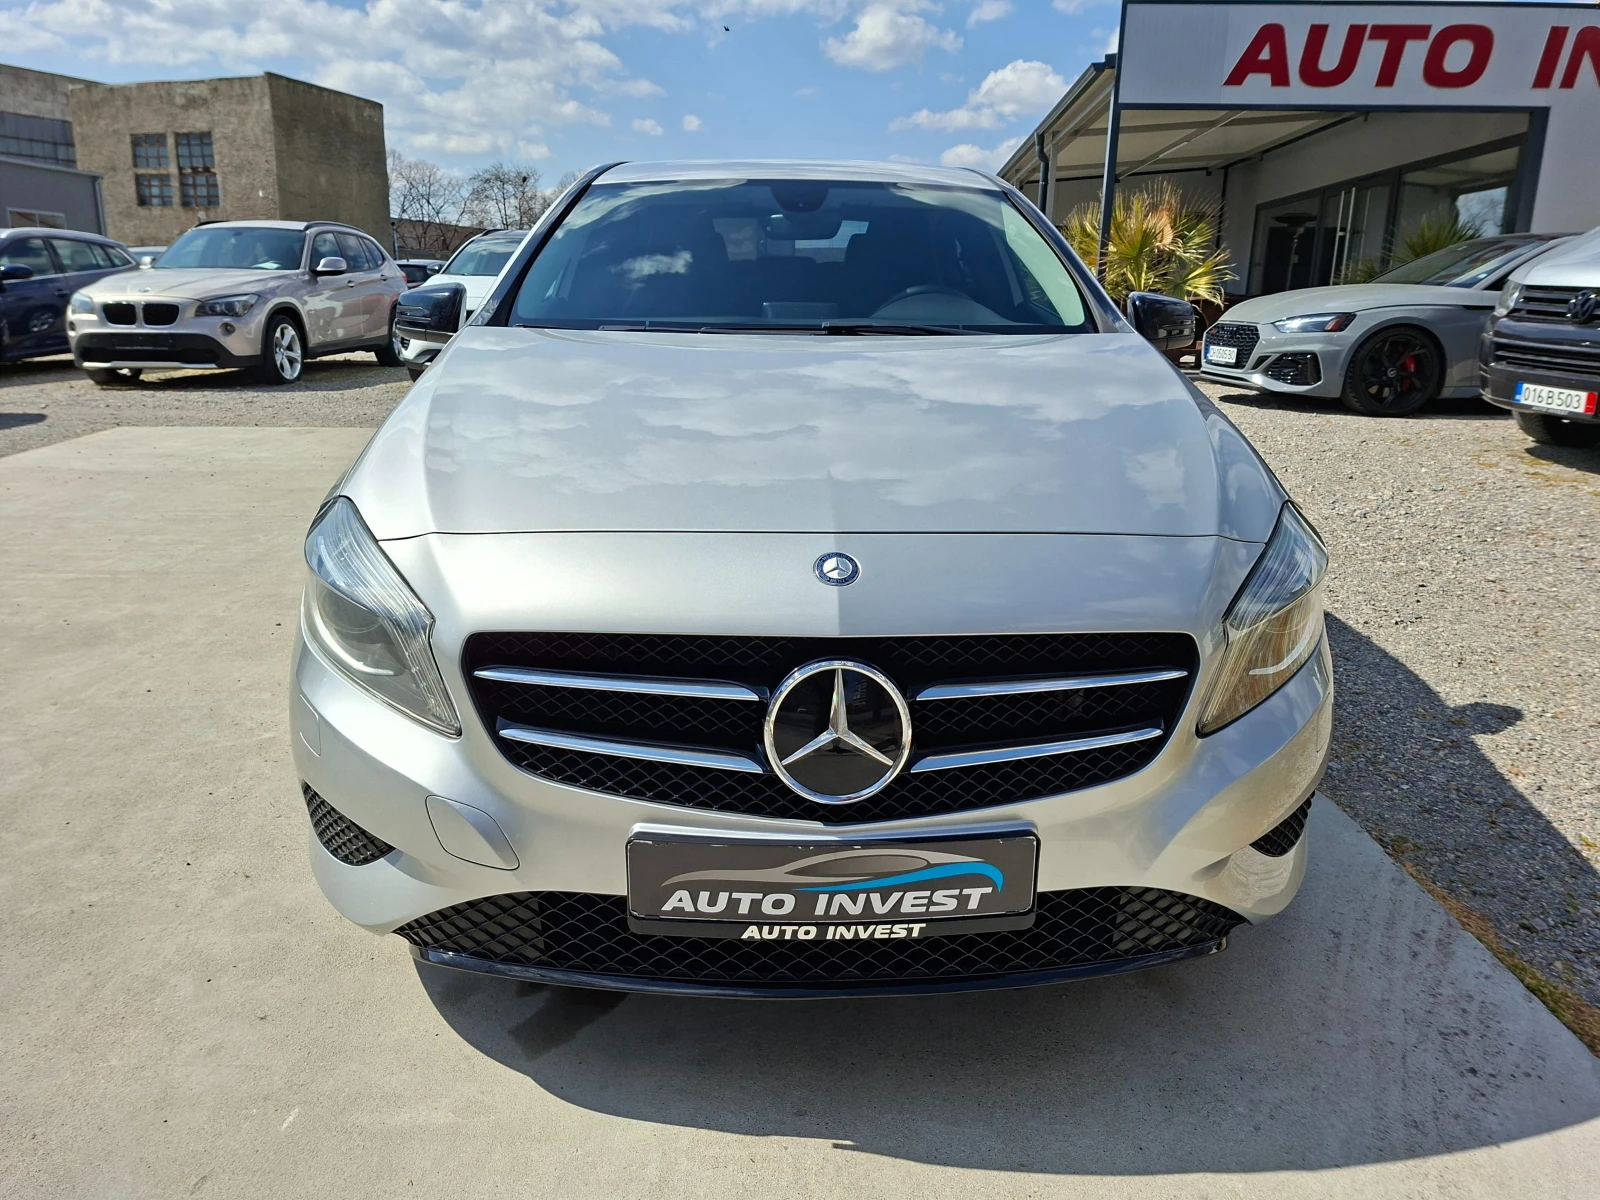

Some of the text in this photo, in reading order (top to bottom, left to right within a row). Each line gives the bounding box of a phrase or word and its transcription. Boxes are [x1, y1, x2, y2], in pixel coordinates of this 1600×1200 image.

[1223, 23, 1494, 88] AUTO
[1523, 387, 1581, 409] 016B503
[661, 887, 993, 916] AUTO INVEST
[741, 923, 926, 940] AUTO INVEST
